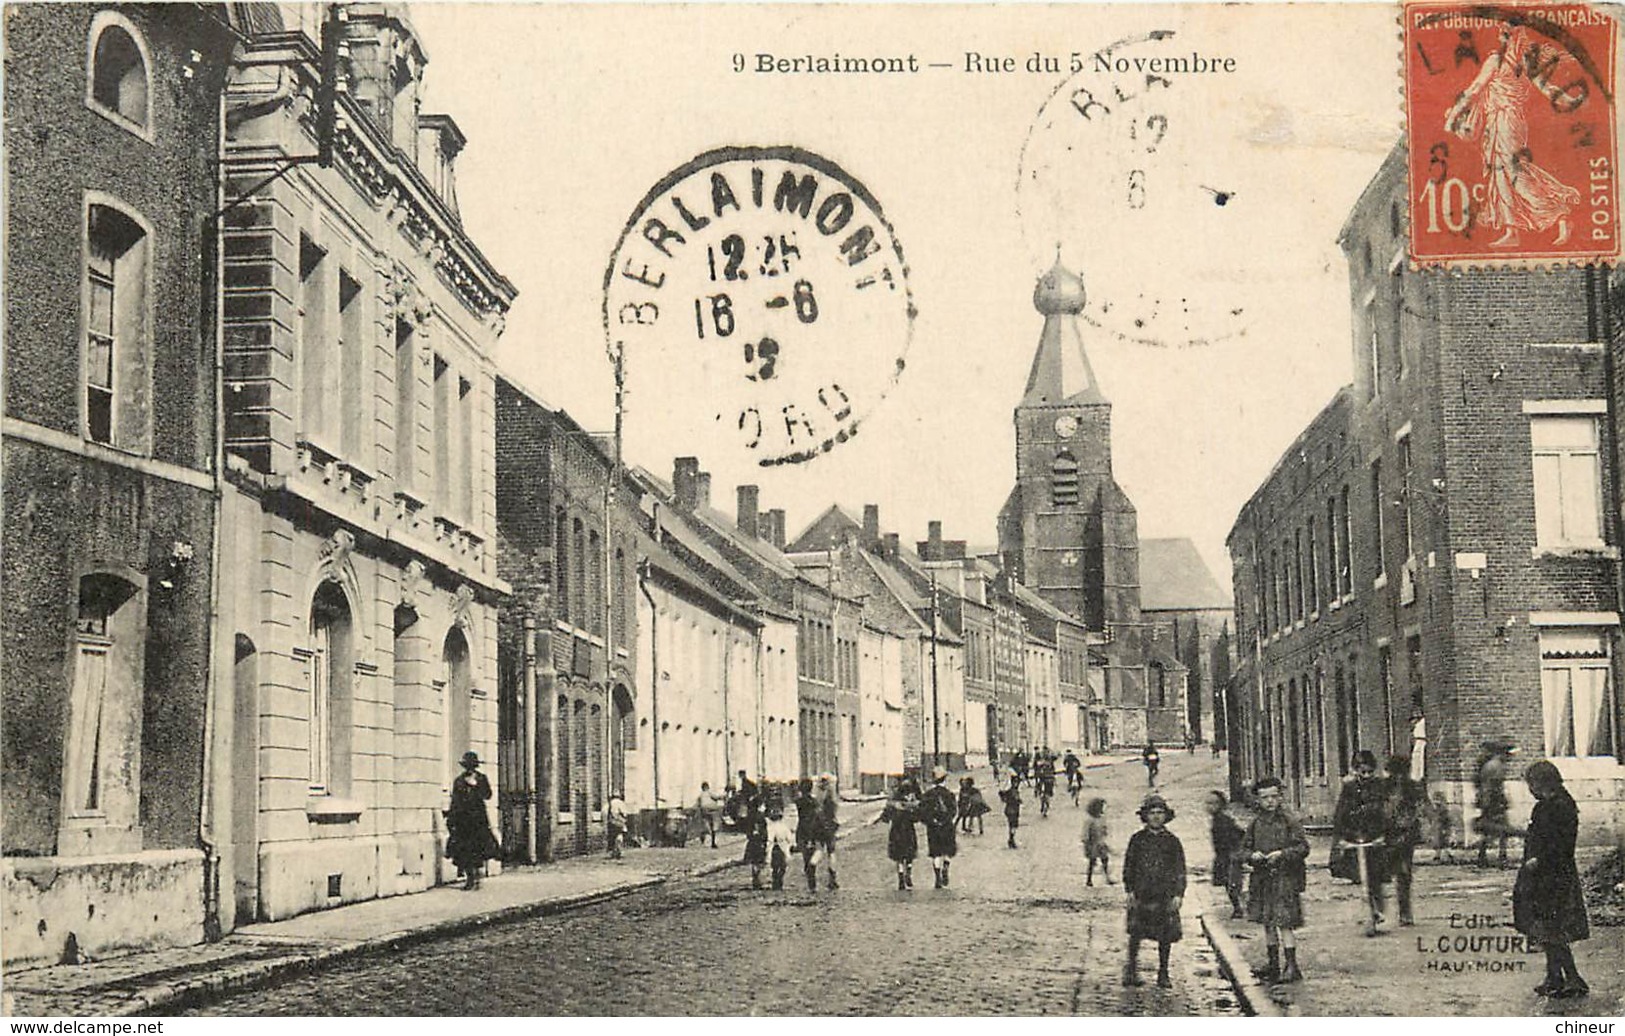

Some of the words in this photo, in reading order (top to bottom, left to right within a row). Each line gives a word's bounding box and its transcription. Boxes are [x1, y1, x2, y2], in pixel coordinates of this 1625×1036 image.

[733, 55, 744, 72] 9
[755, 54, 918, 73] Berlaimont
[966, 53, 1014, 72] Rue
[1027, 53, 1059, 72] du
[1071, 53, 1083, 72] 5
[1095, 52, 1235, 72] Novembre
[1590, 156, 1611, 241] POSTES
[619, 167, 897, 325] BERLAIMONT
